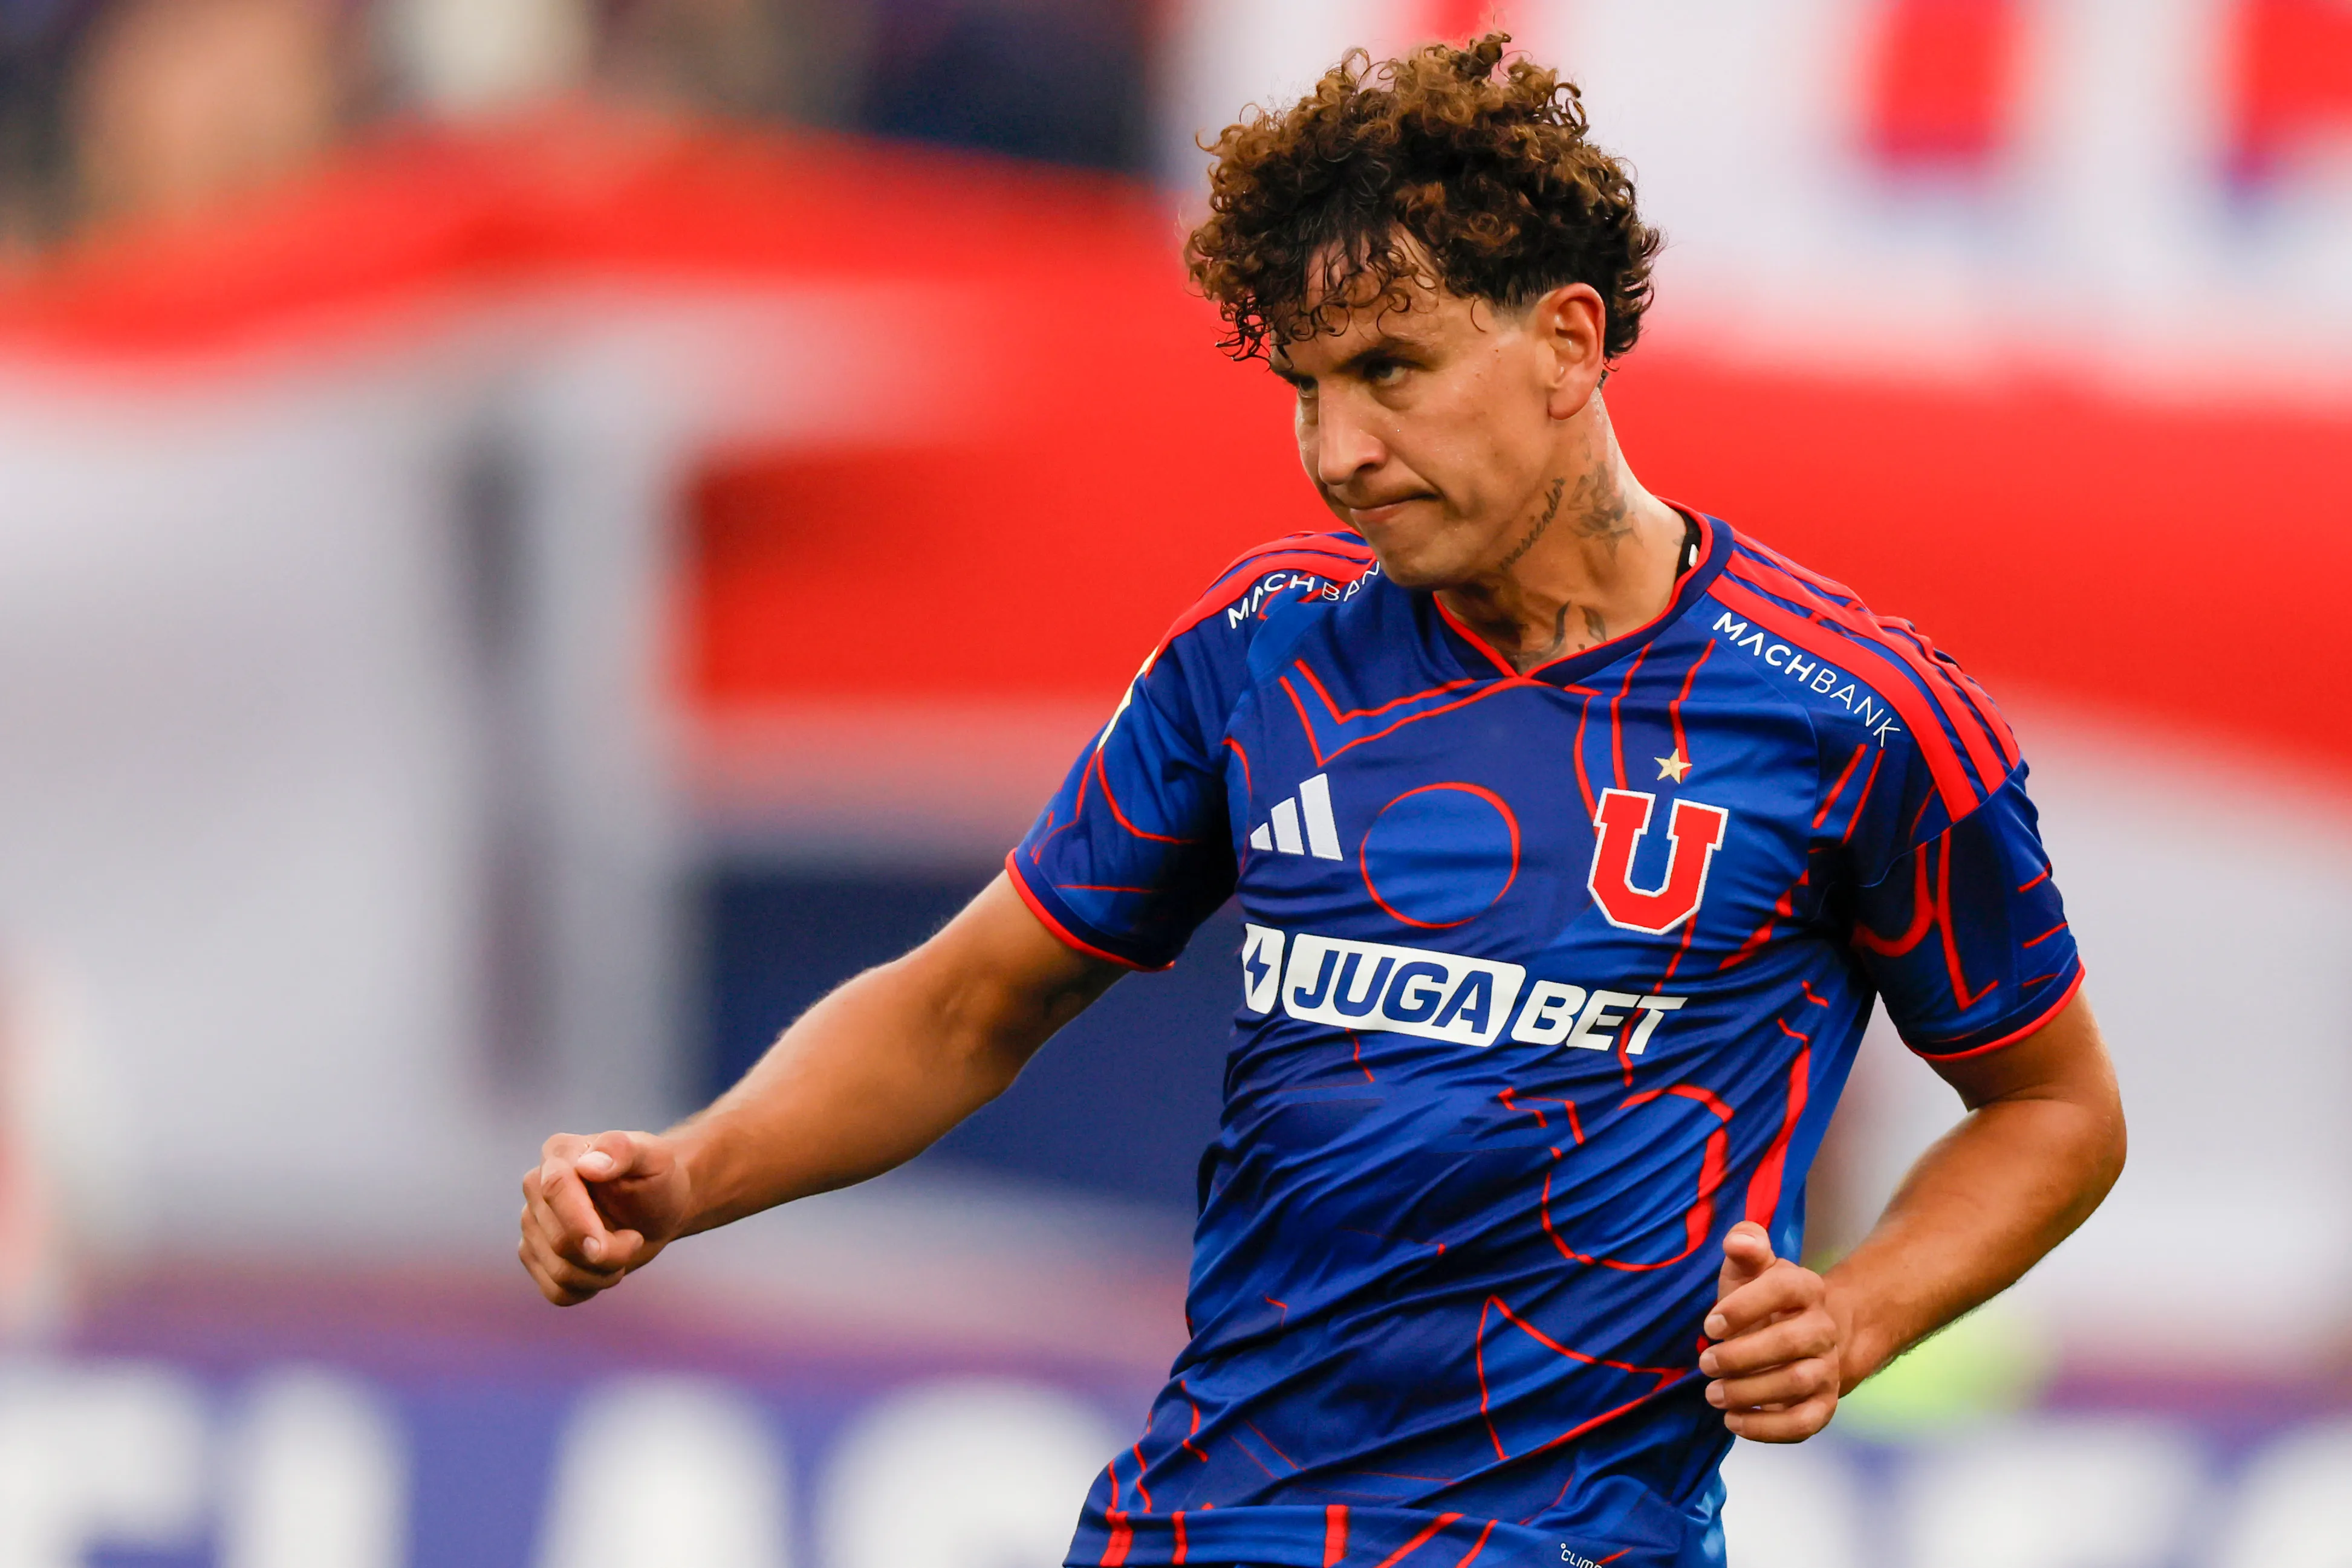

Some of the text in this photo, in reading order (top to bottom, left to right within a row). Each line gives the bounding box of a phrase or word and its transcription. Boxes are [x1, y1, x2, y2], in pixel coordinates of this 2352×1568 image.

[1227, 560, 1380, 629] MACHBAN
[1712, 611, 1902, 748] MACHBANK
[1587, 787, 1730, 936] U
